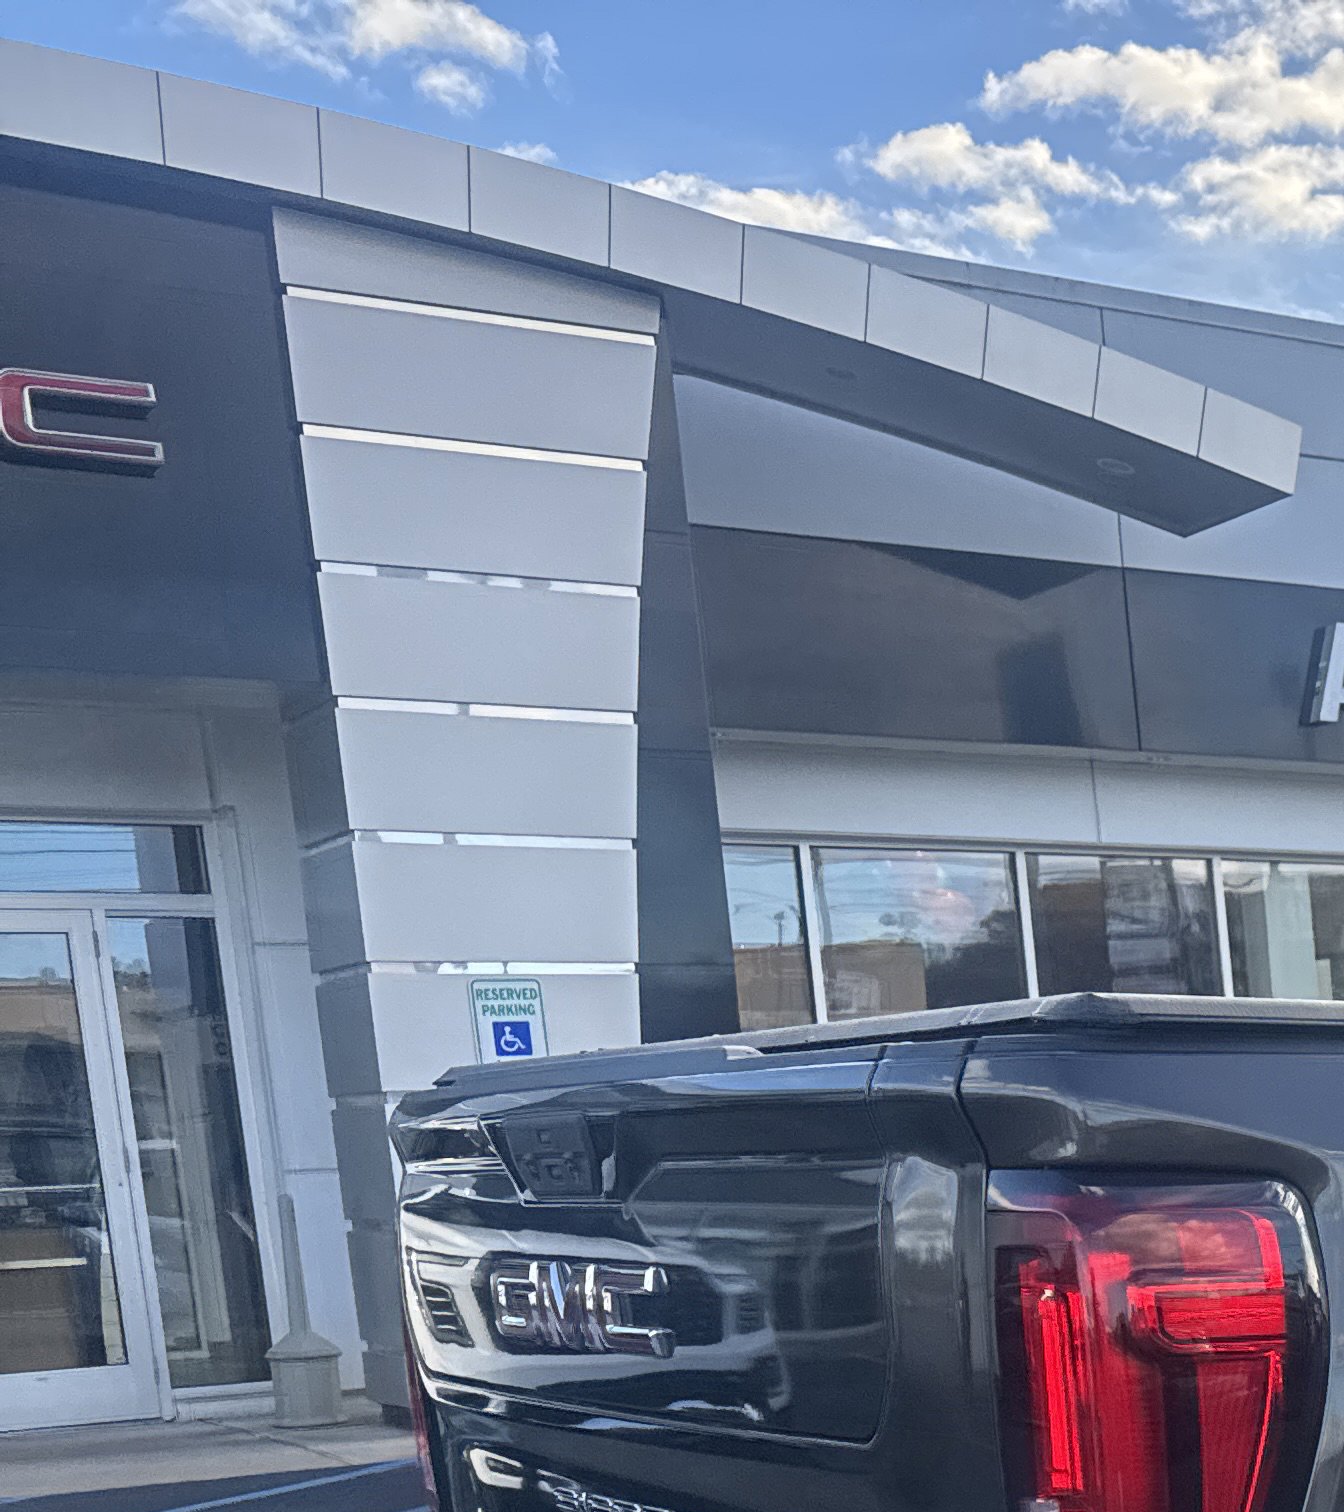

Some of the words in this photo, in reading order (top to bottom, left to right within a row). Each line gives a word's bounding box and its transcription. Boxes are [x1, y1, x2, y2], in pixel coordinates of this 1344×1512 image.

[475, 987, 538, 1001] RESERVED
[481, 1003, 536, 1016] PARKING
[489, 1260, 676, 1359] GMC
